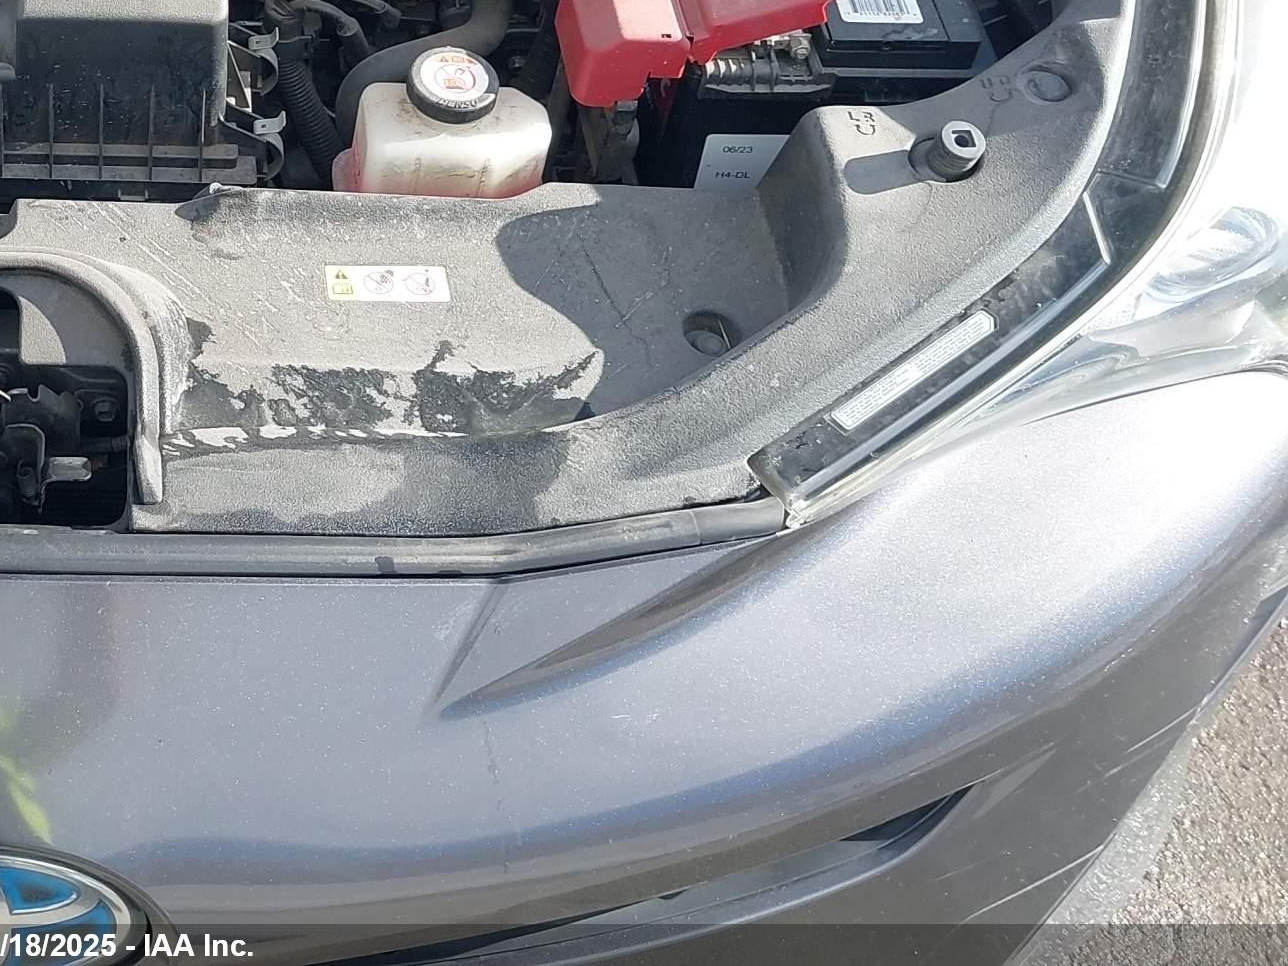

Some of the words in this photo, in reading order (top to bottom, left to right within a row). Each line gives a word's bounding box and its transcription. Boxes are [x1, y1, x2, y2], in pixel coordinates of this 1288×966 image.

[438, 98, 478, 109] DENSO
[722, 145, 753, 154] 06/23
[715, 170, 751, 179] H4-DL
